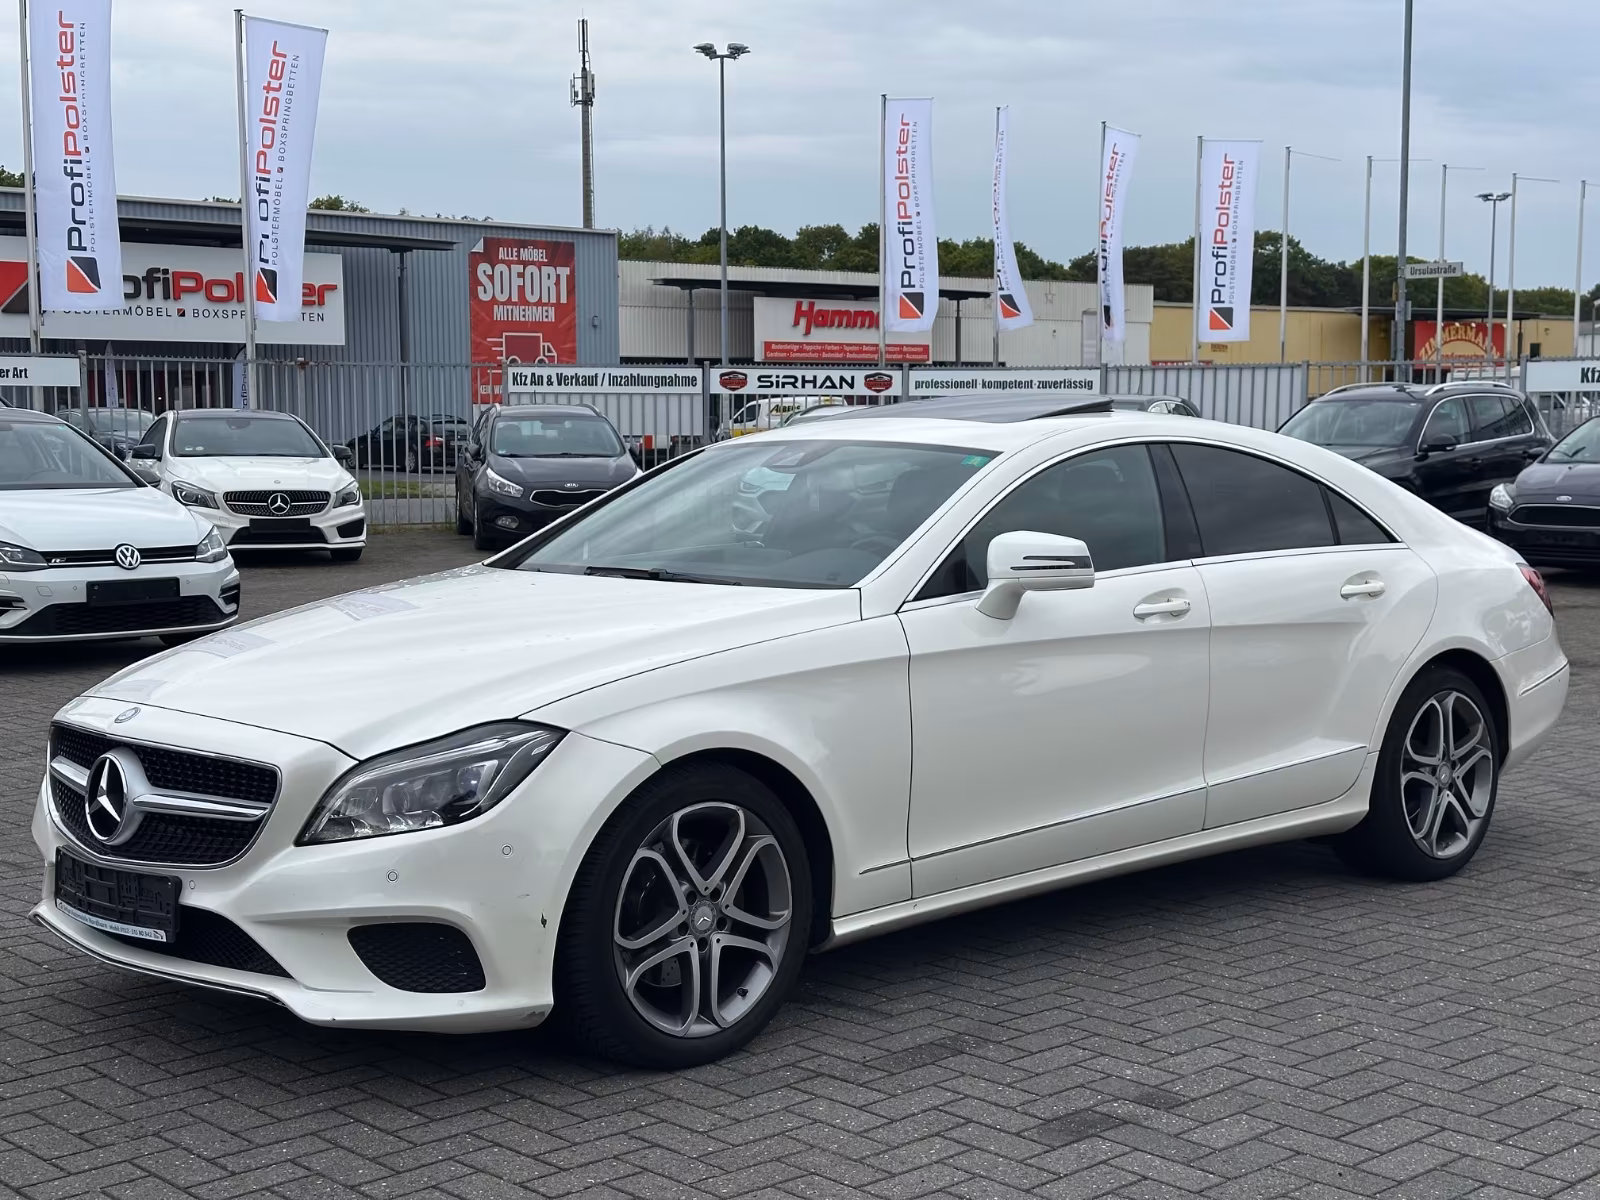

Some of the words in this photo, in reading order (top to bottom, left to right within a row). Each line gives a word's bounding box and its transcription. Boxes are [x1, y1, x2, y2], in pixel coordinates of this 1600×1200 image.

[57, 10, 87, 251] ProfiPolster
[271, 176, 284, 266] POLSTERMÖBEL
[278, 54, 300, 162] BOXSPRINGBETTEN
[86, 157, 96, 253] POLSTERMÖBEL
[895, 113, 916, 288] ProfiPolster
[1211, 153, 1235, 304] ProfiPolster
[498, 247, 518, 261] ALLE
[519, 246, 548, 262] MÖBEL
[1410, 265, 1457, 275] Ursulastraße
[477, 263, 570, 304] SOFORT
[494, 305, 555, 322] MITNEHMEN
[12, 366, 28, 379] Art
[512, 372, 528, 387] Kfz
[530, 372, 543, 387] An
[546, 374, 554, 387] &
[556, 372, 598, 387] Verkauf
[608, 373, 697, 389] Inzahlungnahme
